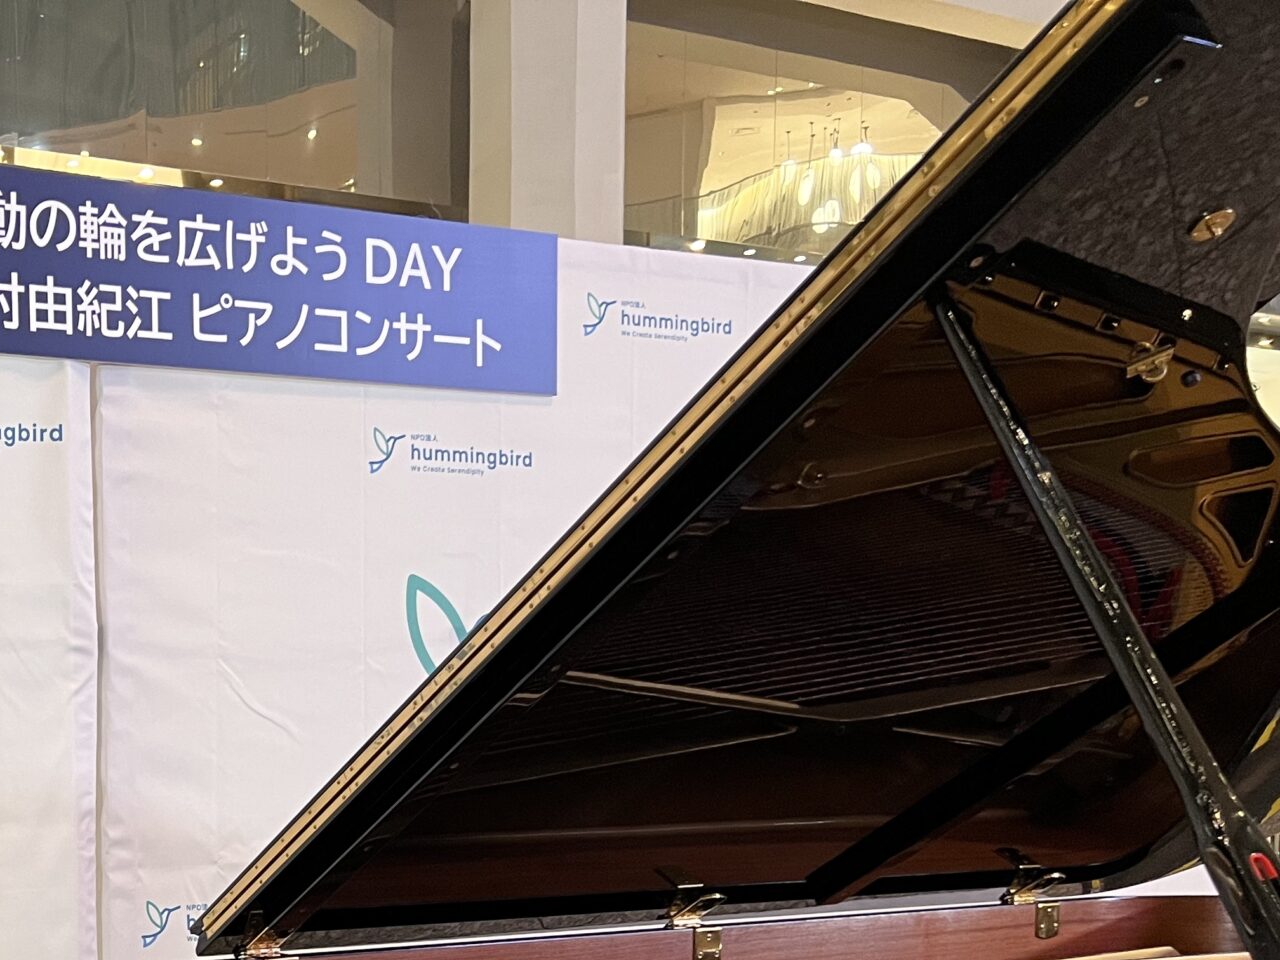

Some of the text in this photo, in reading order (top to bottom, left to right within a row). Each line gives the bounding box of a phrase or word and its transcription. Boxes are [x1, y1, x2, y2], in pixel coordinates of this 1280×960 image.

[365, 237, 463, 292] DAY
[192, 292, 502, 368] ピアノコンサート
[621, 309, 732, 337] hummingbird
[410, 443, 533, 470] hummingbird
